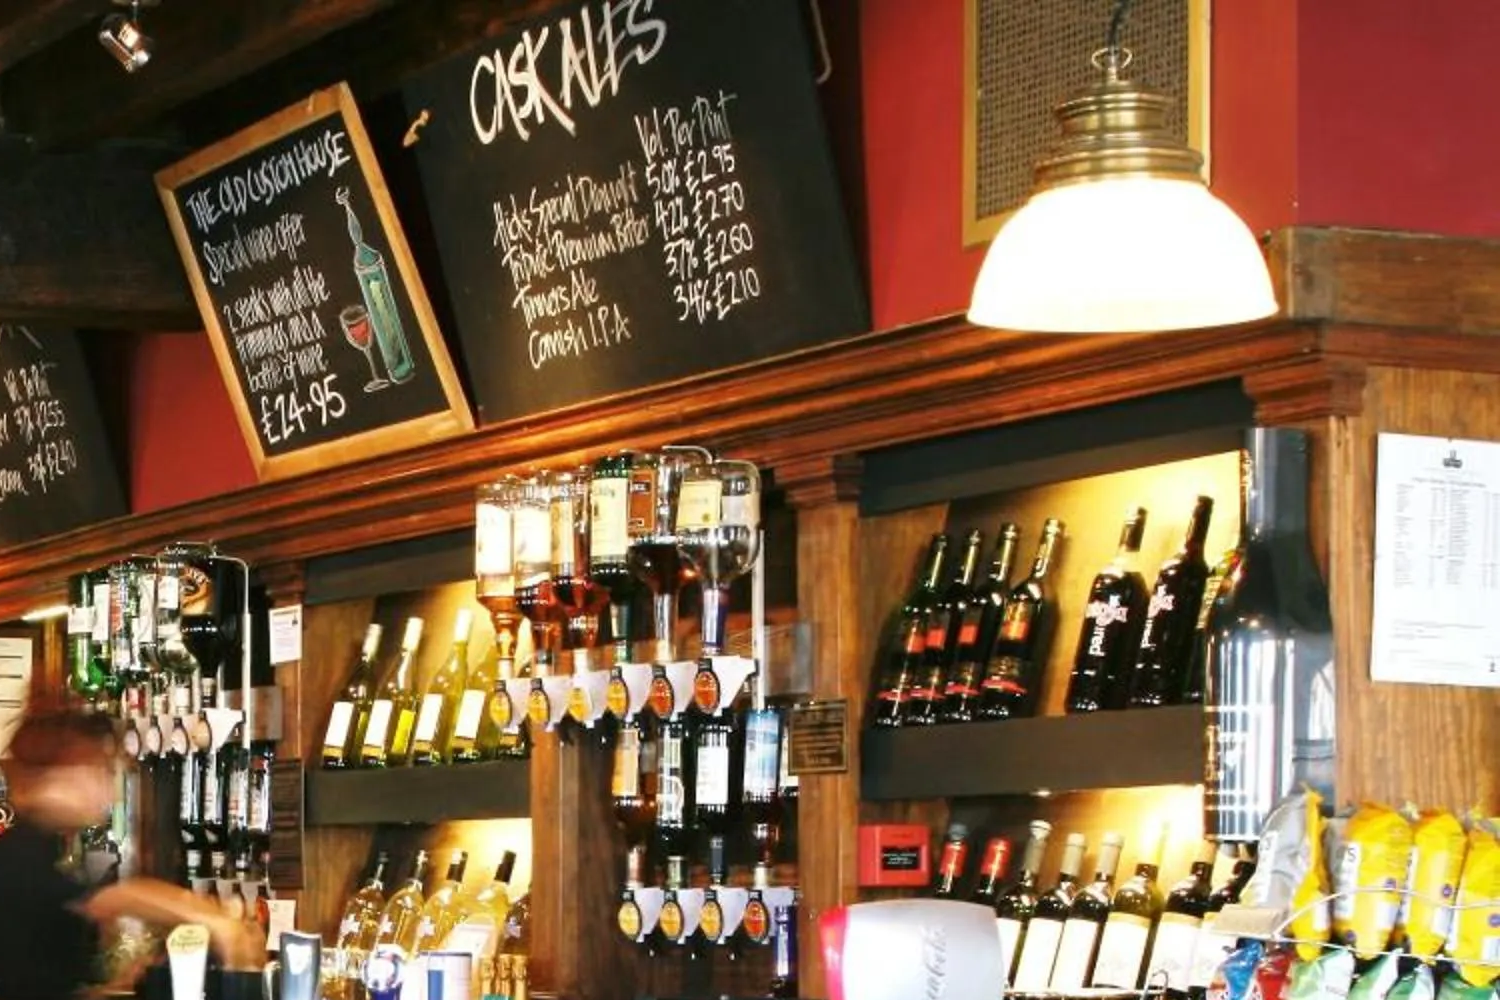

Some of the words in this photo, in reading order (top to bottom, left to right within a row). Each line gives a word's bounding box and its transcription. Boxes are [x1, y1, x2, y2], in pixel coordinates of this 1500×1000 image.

[470, 25, 577, 145] CASK
[559, 0, 668, 109] ALES
[185, 187, 222, 233] THE
[219, 175, 248, 216] OLD
[247, 151, 301, 206] CUSTOM
[294, 129, 351, 179] HOUSE
[570, 267, 599, 310] Ale
